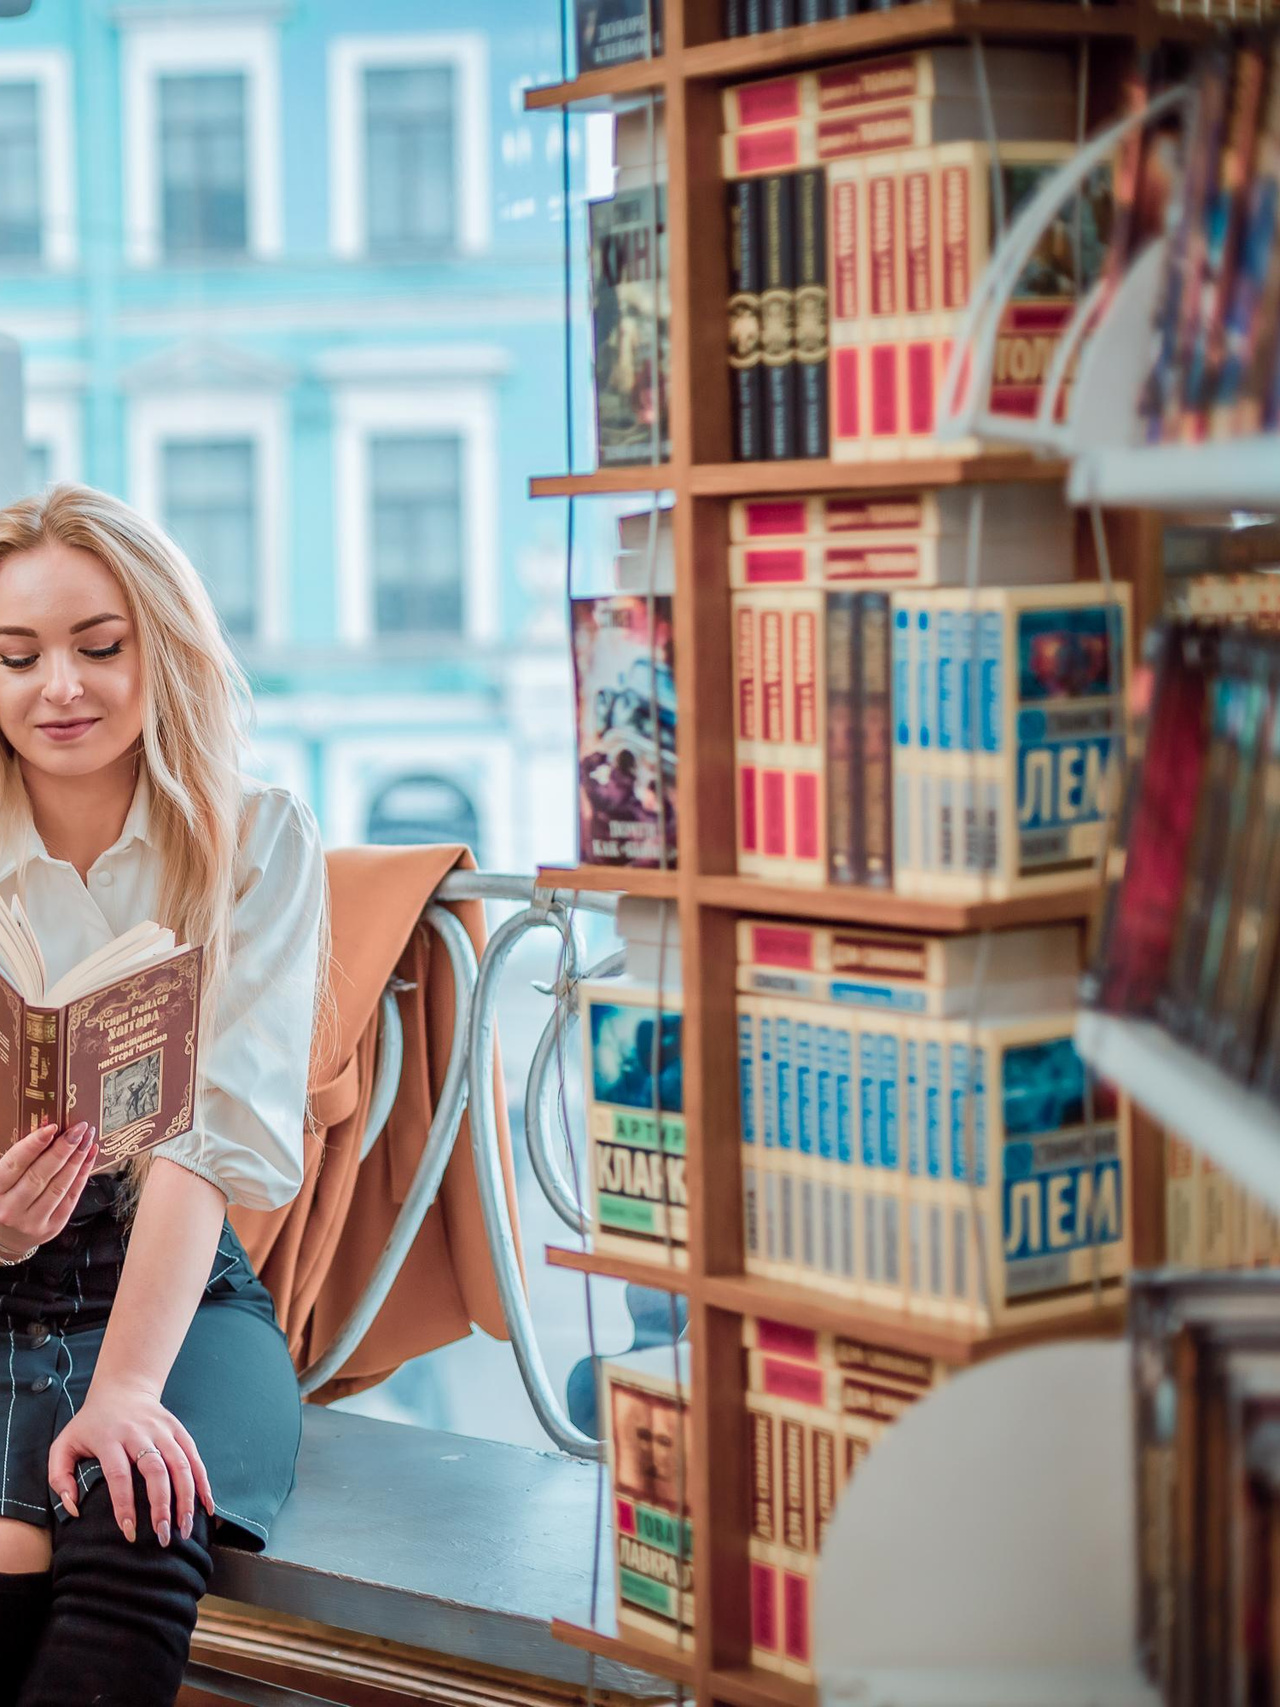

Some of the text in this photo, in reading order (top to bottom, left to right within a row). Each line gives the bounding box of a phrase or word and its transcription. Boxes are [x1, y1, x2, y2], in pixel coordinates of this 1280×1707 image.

[98, 993, 170, 1032] Генри Райдер
[107, 1009, 160, 1042] Хаггард
[1006, 1166, 1118, 1255] ЛЕМ
